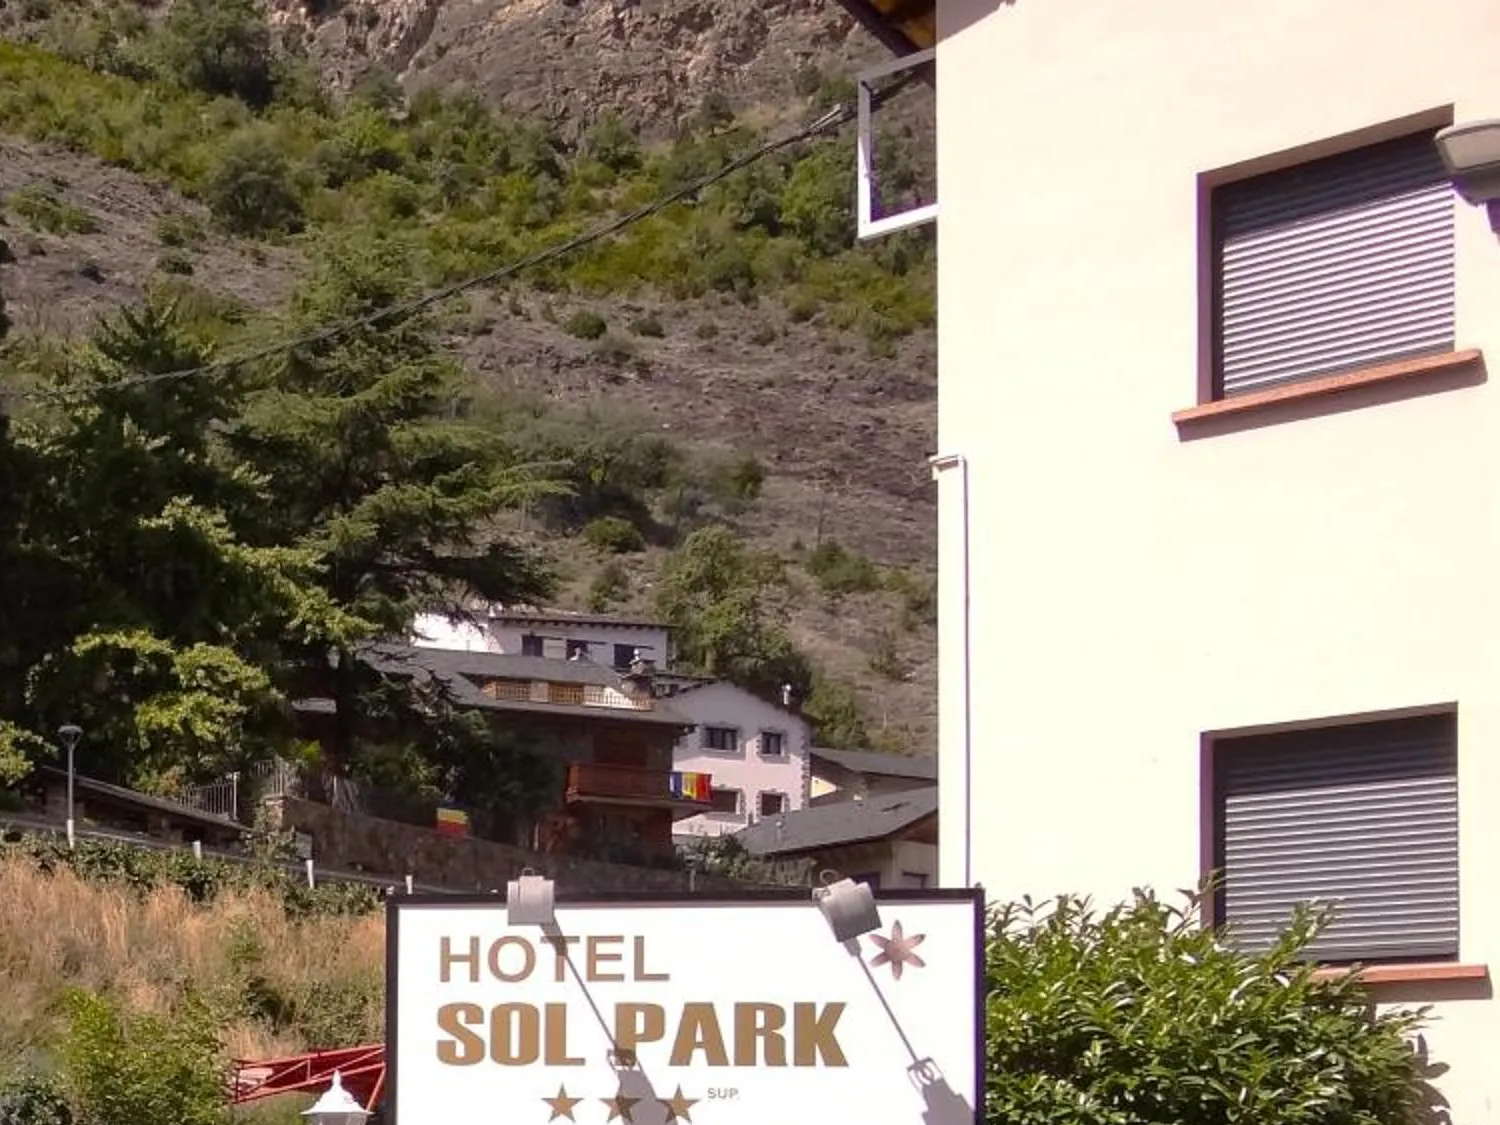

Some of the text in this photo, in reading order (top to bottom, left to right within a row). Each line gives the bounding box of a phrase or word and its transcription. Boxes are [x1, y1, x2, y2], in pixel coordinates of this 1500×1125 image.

[439, 934, 670, 983] HOTEL
[436, 1001, 850, 1068] SOL PARK
